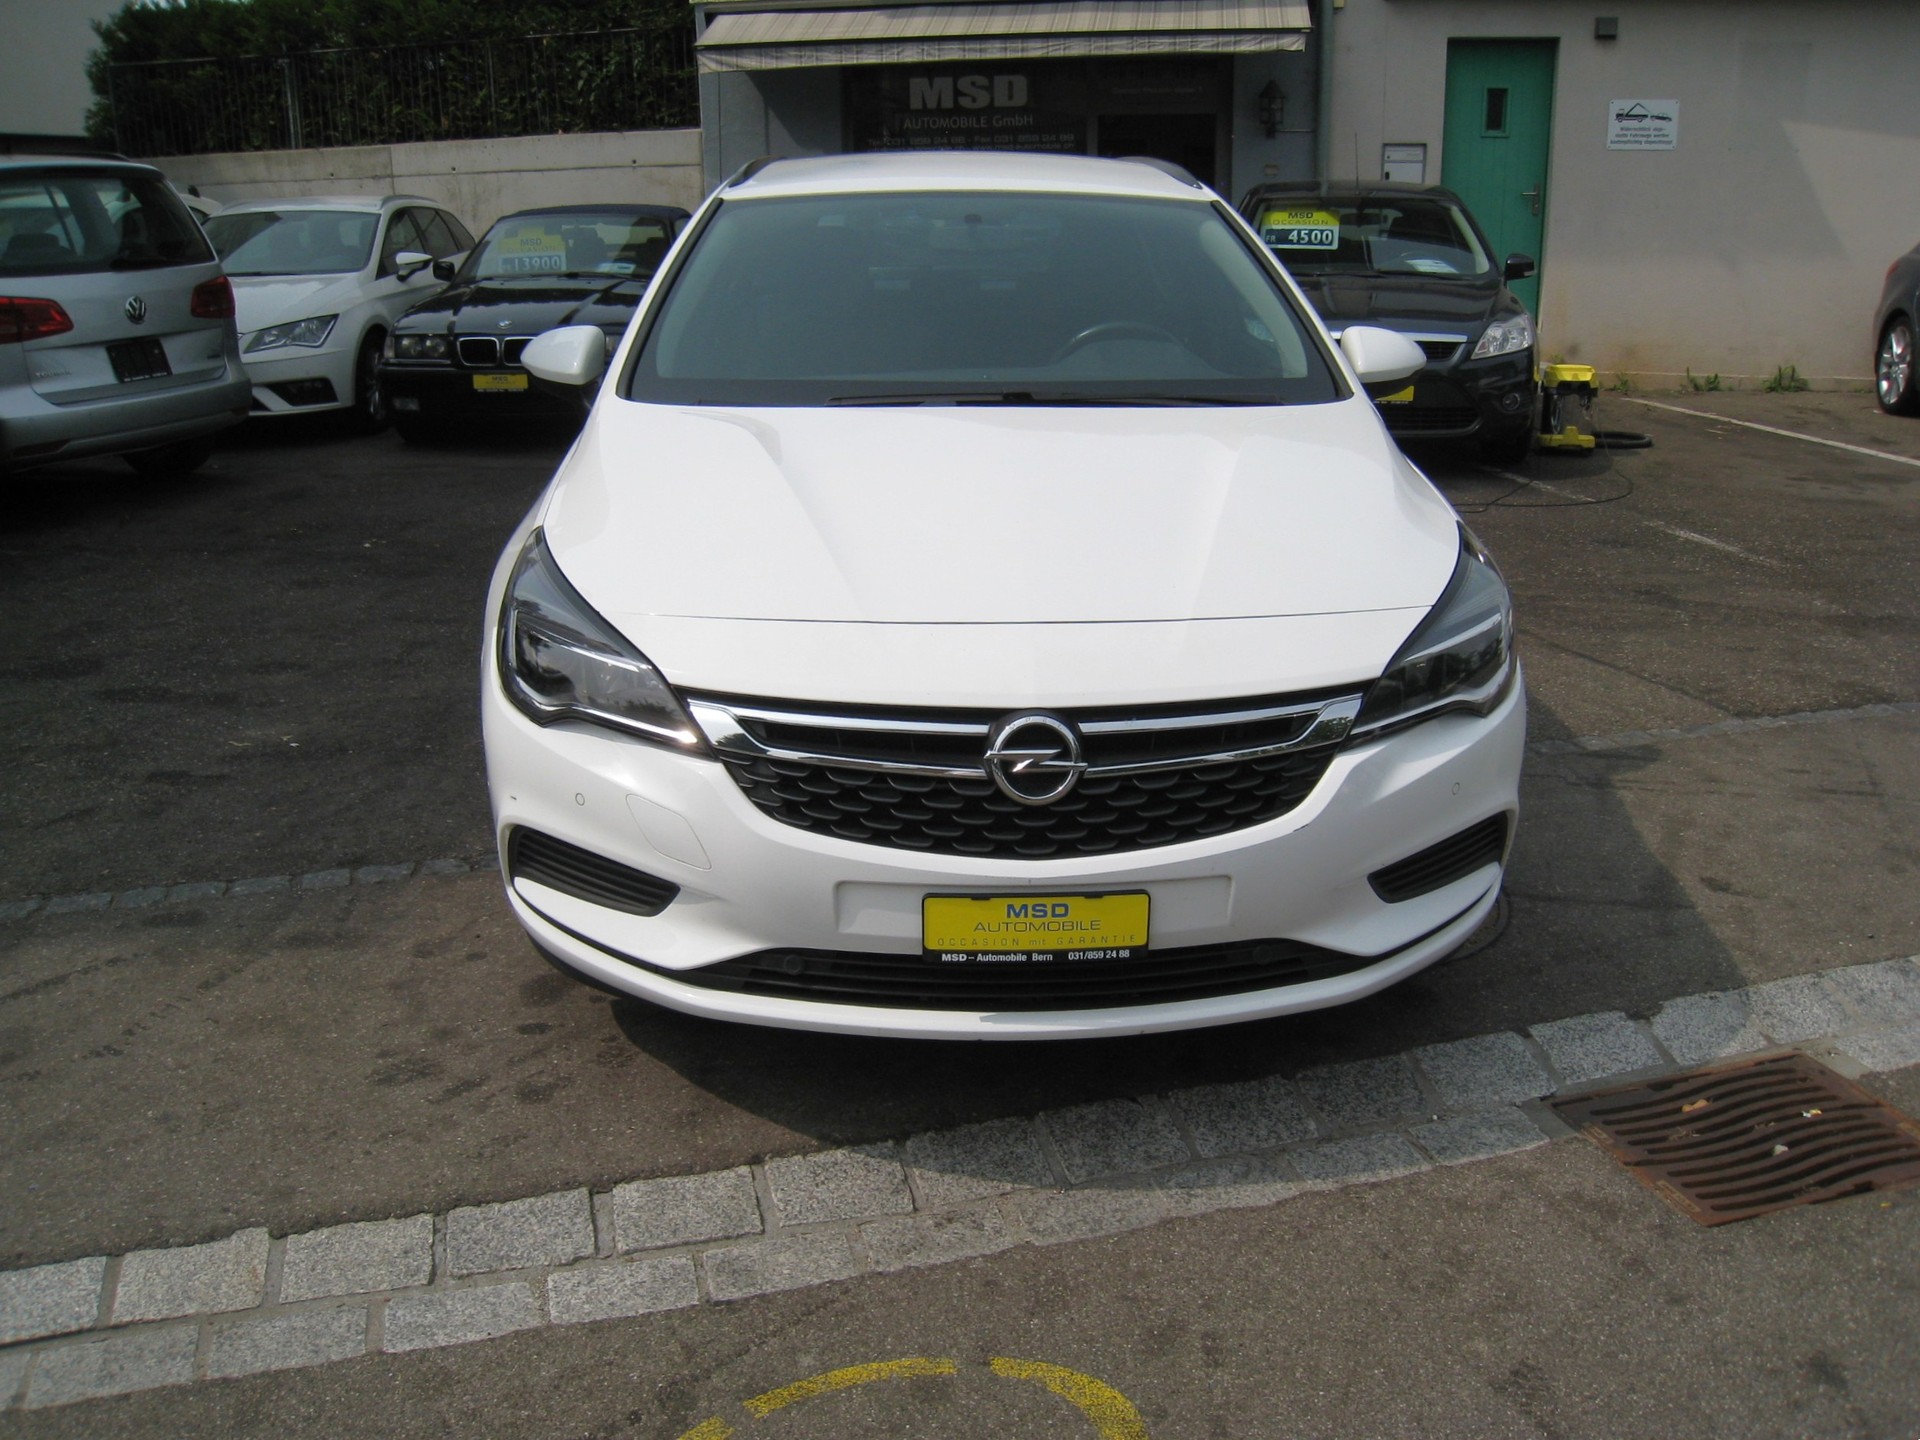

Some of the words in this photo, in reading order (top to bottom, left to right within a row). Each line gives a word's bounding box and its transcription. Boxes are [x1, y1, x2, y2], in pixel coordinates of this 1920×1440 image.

[909, 74, 1028, 110] MSD
[903, 116, 988, 129] AUTOMOBILE
[992, 114, 1033, 127] GmbH
[1288, 211, 1313, 219] MSD
[520, 238, 542, 246] MSD
[1265, 235, 1276, 243] FR
[1288, 230, 1332, 243] 4500
[514, 256, 560, 271] 13900
[1006, 903, 1069, 919] MSD
[973, 920, 1101, 933] AUTOMOBILE
[937, 937, 1020, 947] OCCASION
[1028, 937, 1046, 946] mit
[1057, 934, 1136, 946] GARANTIE
[941, 952, 967, 962] MSD
[976, 951, 1027, 962] Automobile
[1032, 951, 1053, 962] Bern
[1068, 949, 1104, 961] 031/859
[1105, 949, 1118, 960] 24
[1118, 949, 1130, 959] 88
